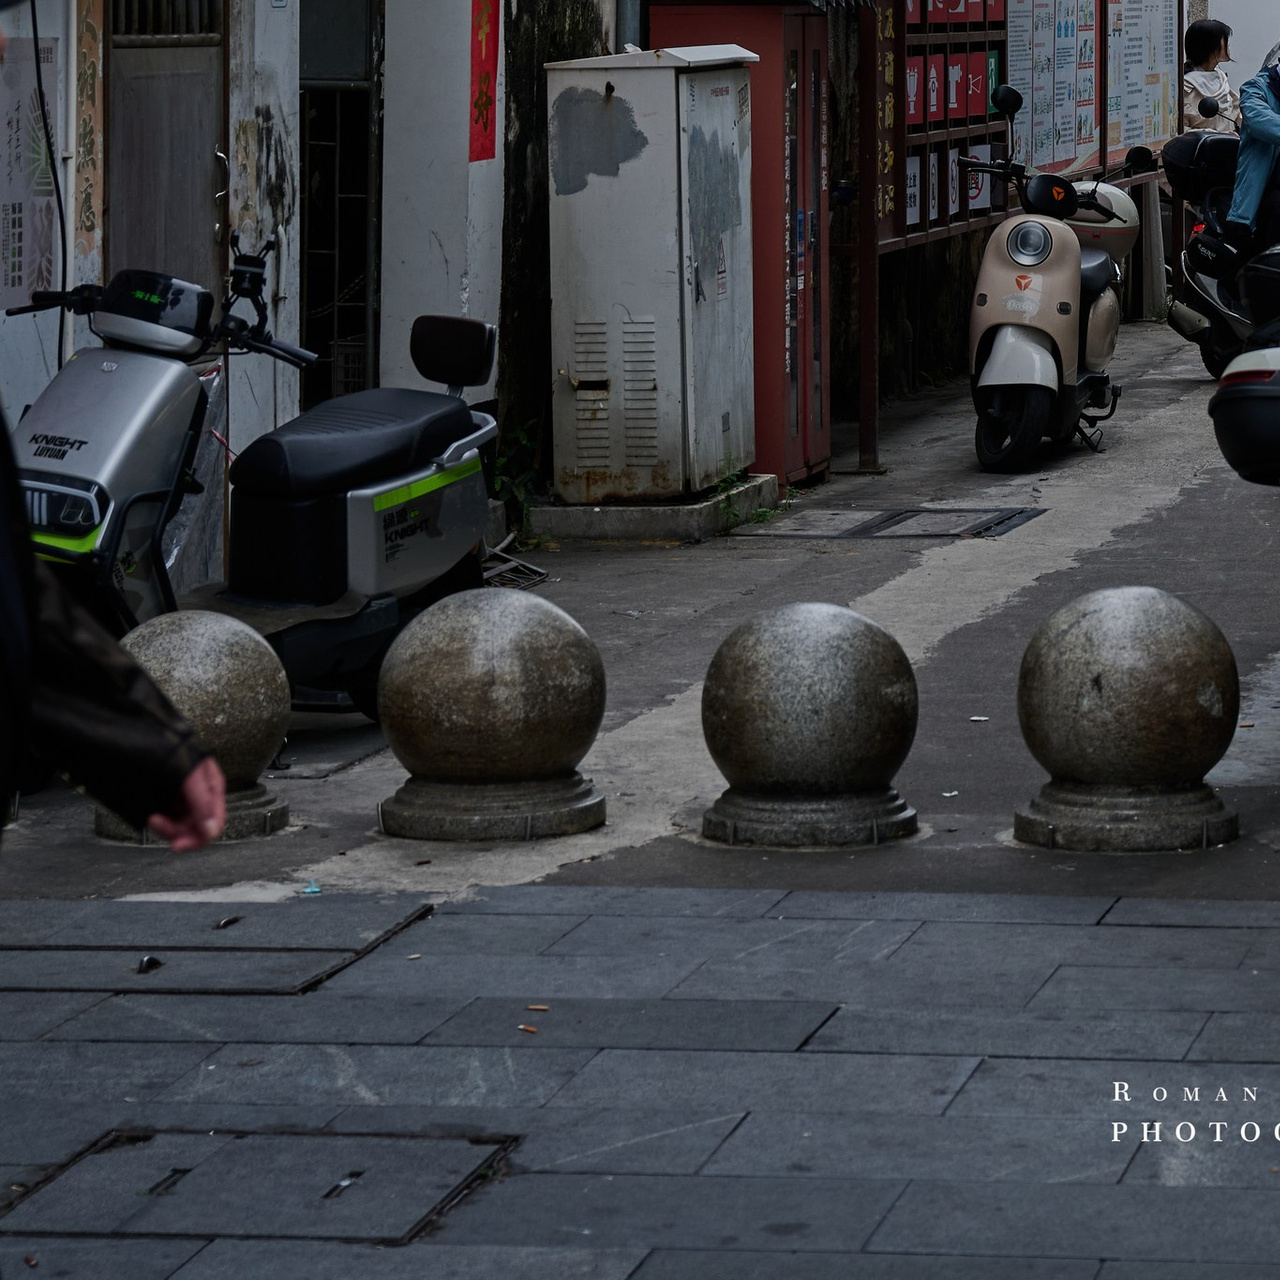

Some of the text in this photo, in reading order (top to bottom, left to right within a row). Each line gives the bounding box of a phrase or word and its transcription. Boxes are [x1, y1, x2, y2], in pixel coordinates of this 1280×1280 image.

[29, 433, 89, 451] KNIGHT
[33, 445, 69, 461] LUYUAN
[385, 518, 430, 544] KNIGHT
